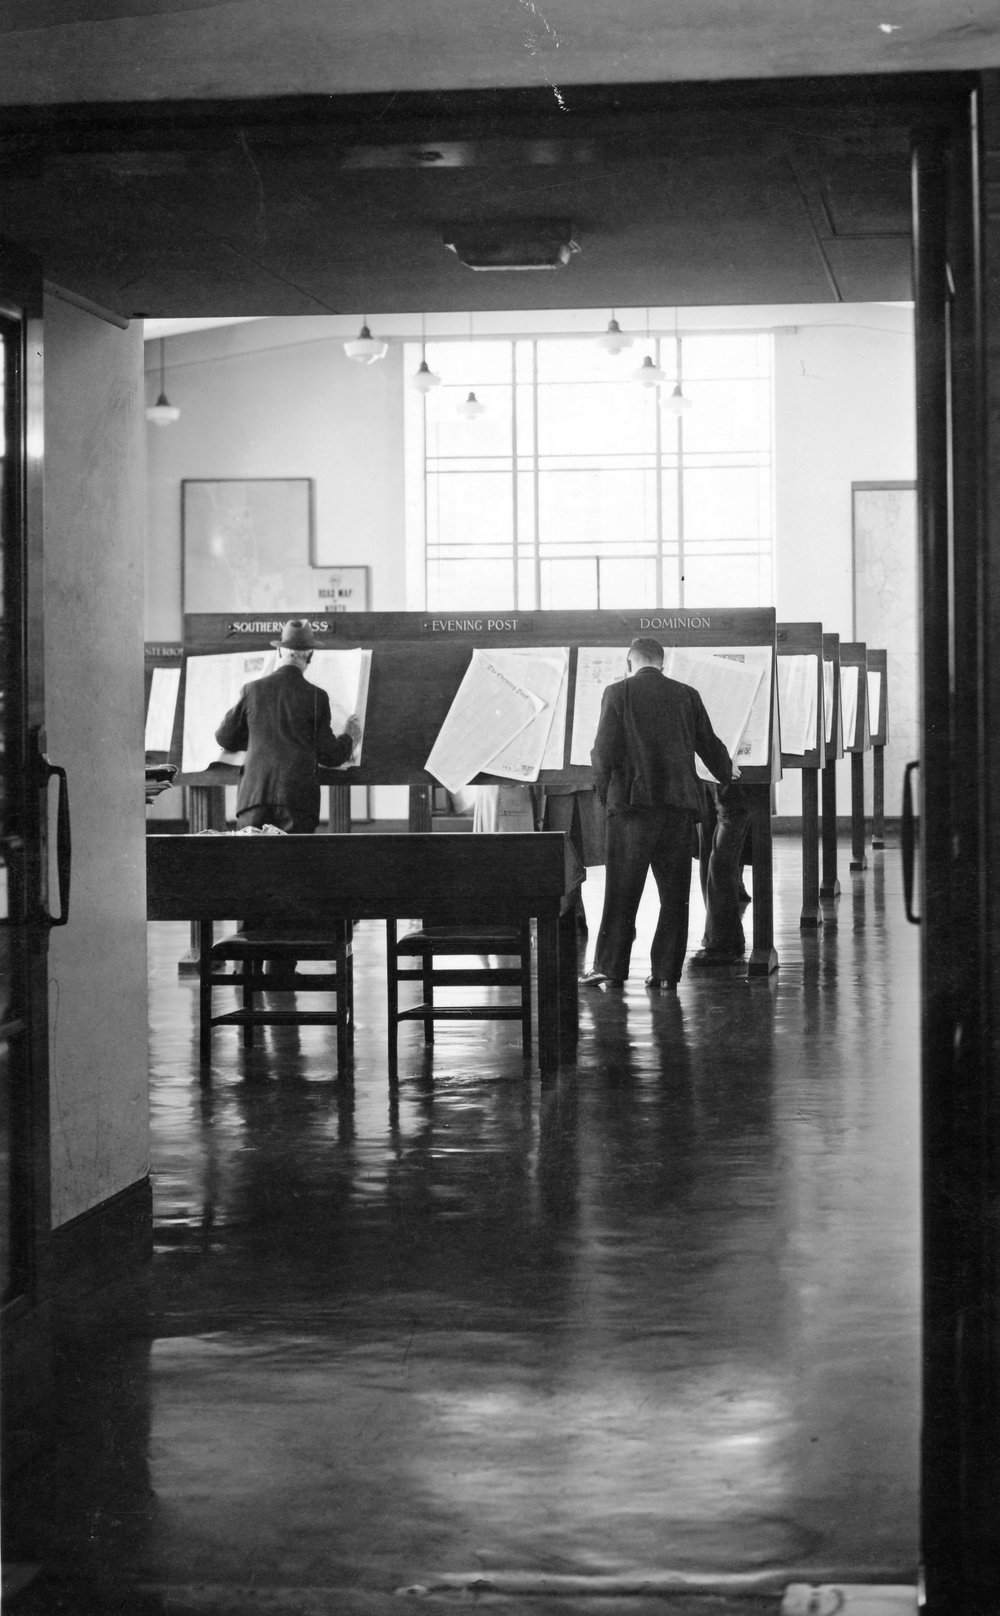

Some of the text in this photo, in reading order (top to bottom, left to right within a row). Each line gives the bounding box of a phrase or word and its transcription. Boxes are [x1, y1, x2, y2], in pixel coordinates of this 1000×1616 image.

[338, 588, 352, 598] MAP
[432, 619, 519, 631] EVENING POST
[640, 617, 712, 629] DOMINION
